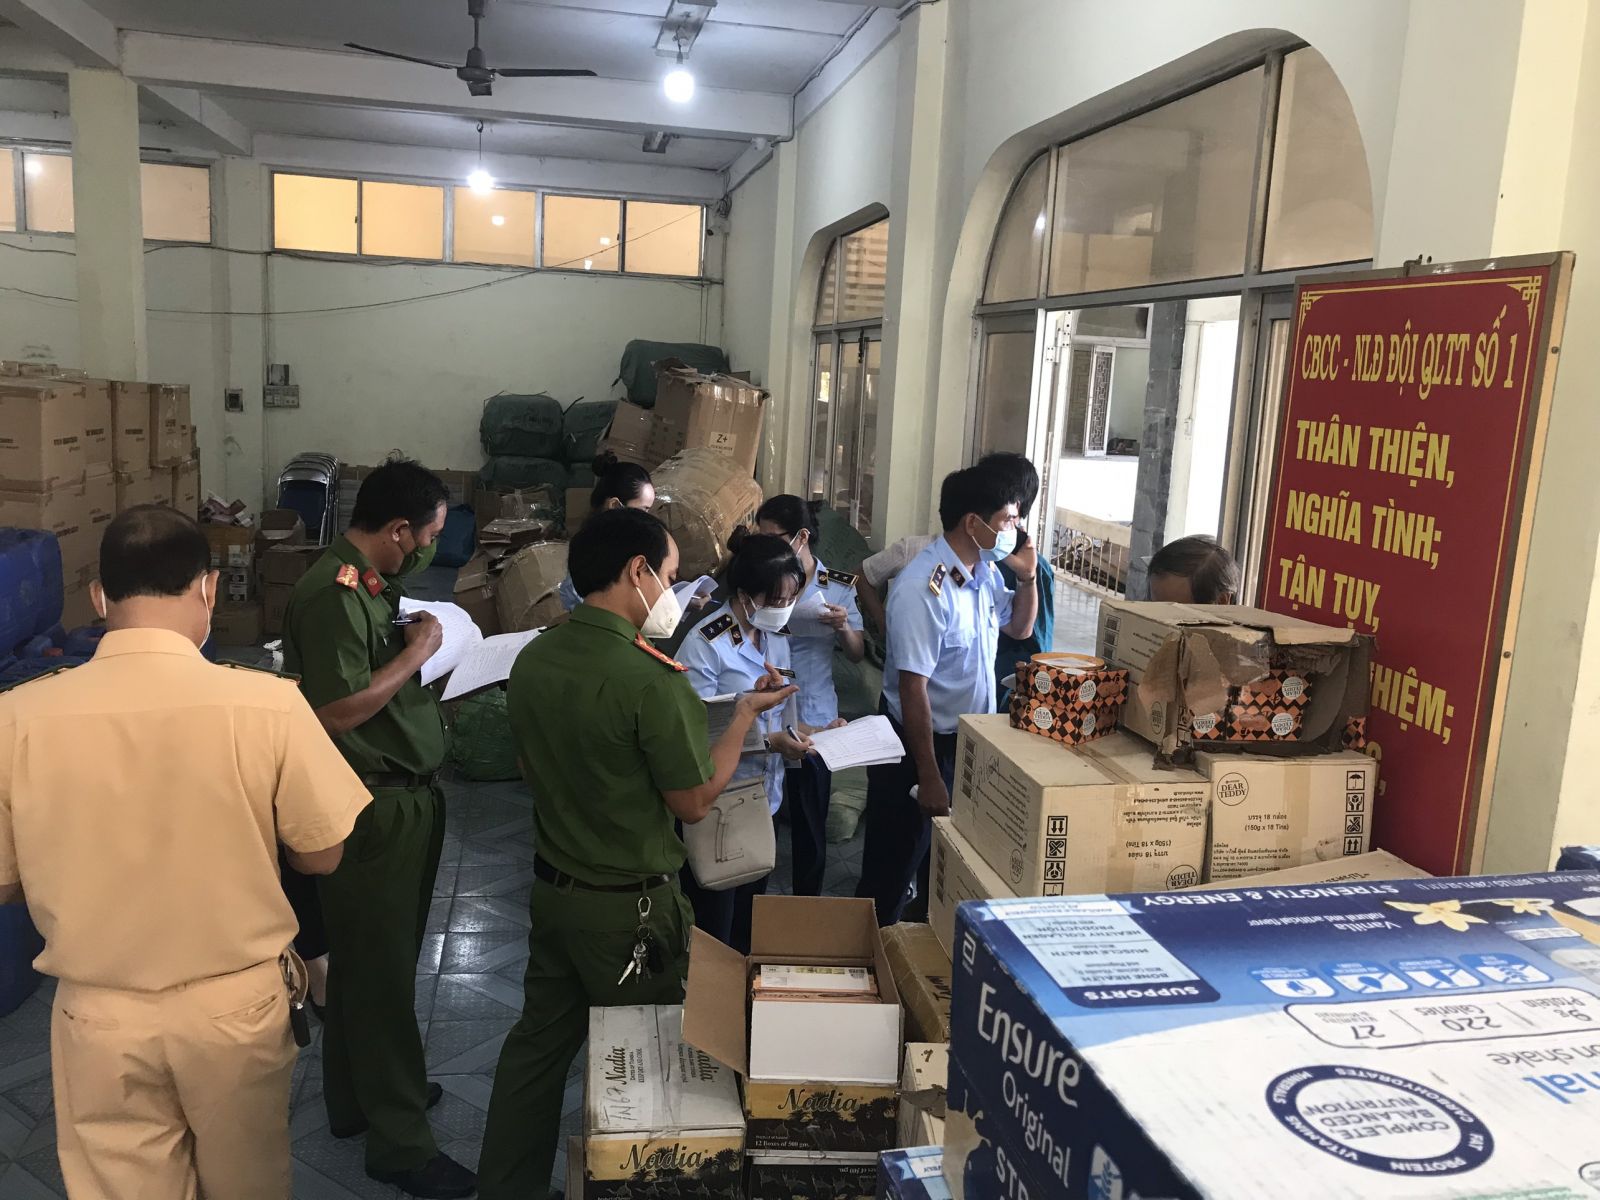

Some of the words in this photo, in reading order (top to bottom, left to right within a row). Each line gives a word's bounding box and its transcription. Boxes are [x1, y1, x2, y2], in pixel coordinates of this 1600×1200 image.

[1302, 334, 1341, 381] CBCC
[1352, 334, 1384, 382] NLĐ
[1386, 318, 1419, 396] ĐỘI
[1419, 332, 1470, 400] QLTT
[1472, 304, 1507, 389] SỐ
[1504, 333, 1518, 388] 1
[1296, 414, 1361, 468] THÂN
[1369, 421, 1455, 489] THIỆN,
[1285, 489, 1361, 545] NGHĨA
[1371, 498, 1442, 570] TÌNH;
[1279, 554, 1326, 611] TẬN
[1332, 572, 1381, 633] TỤY,
[1370, 661, 1455, 745] HIỆM;
[1219, 789, 1246, 799] TEDDY
[1221, 782, 1244, 793] DEAR
[1263, 813, 1271, 821] 18
[1244, 823, 1261, 833] (150g
[1267, 823, 1275, 831] 18
[1275, 822, 1290, 832] Tins)
[1125, 840, 1140, 848] Tins)
[1154, 839, 1172, 847] (150g
[1168, 871, 1196, 880] TEDDY
[1171, 878, 1194, 887] DEAR
[1141, 890, 1243, 906] ENERGY
[1244, 891, 1264, 900] &
[1270, 884, 1400, 899] STRENGTH
[1247, 918, 1282, 927] flavor
[1281, 915, 1323, 926] artificial
[1323, 914, 1345, 923] and
[1344, 911, 1386, 922] natural
[1036, 924, 1115, 934] PRODUCTION
[1085, 930, 1142, 938] HEALTHY
[1333, 921, 1402, 932] Vanilla
[1022, 931, 1083, 940] COLLAGEN
[1051, 949, 1100, 957] HEALTH
[1102, 947, 1149, 956] MUSCLE
[1082, 974, 1133, 983] HEALTH
[1135, 973, 1169, 982] BONE
[1084, 985, 1200, 1001] SUPPORTS
[1521, 996, 1585, 1009] Protein
[1414, 1004, 1485, 1019] Calories
[1442, 1015, 1502, 1033] 220
[1351, 1024, 1386, 1041] 27
[977, 981, 1081, 1109] Ensure
[1486, 1047, 1575, 1069] shake
[605, 1047, 628, 1085] Nadia
[696, 1050, 719, 1082] adia
[1271, 1069, 1314, 1105] MINERALS
[777, 1088, 858, 1112] Nadia
[1333, 1067, 1475, 1124] CARBOHYDRATES
[1320, 1108, 1435, 1128] BALANCED
[1002, 1069, 1072, 1189] Original
[1329, 1120, 1451, 1141] COMPLETE,
[1284, 1114, 1359, 1162] VITAMINS
[1468, 1133, 1485, 1152] FAT
[619, 1143, 705, 1171] Nadia
[1389, 1155, 1468, 1173] PROTEIN
